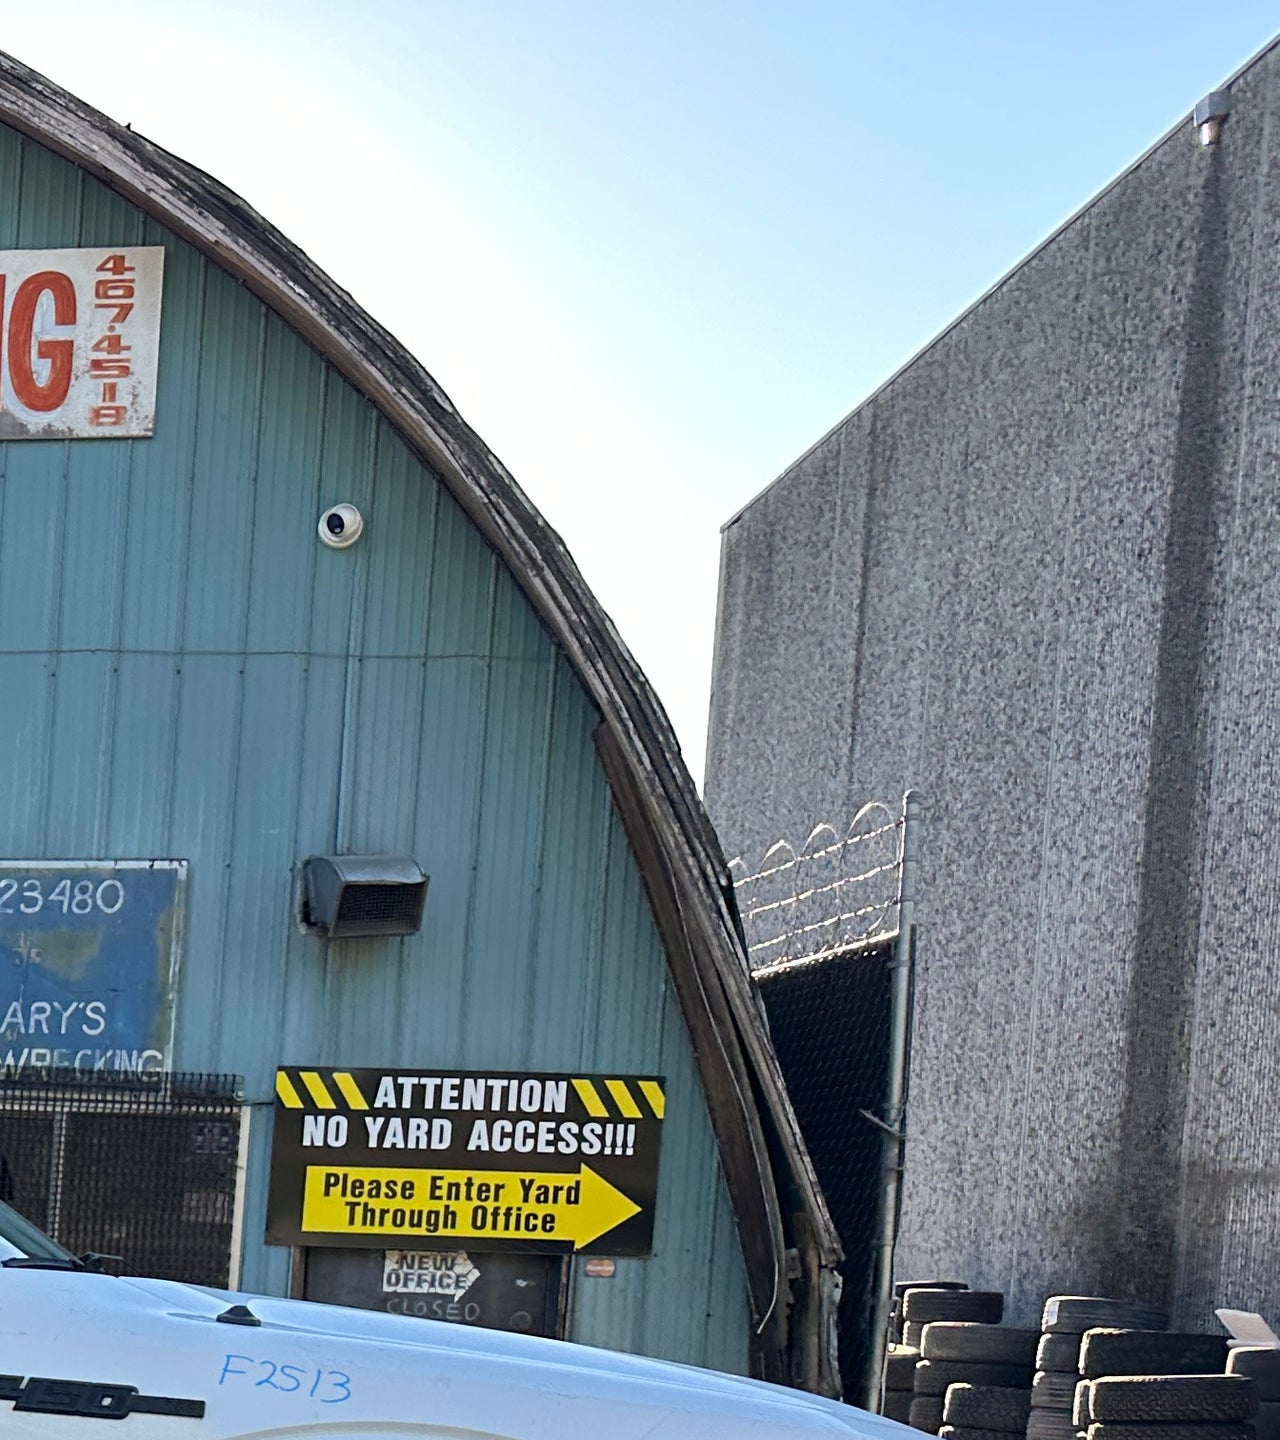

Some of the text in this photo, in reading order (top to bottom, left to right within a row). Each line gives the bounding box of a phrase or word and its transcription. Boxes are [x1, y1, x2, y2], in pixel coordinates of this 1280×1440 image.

[374, 1075, 569, 1114] ATTENTION
[302, 1115, 637, 1156] NO YARD ACCESS!!!
[323, 1172, 581, 1206] Please Enter Yard
[344, 1201, 556, 1234] Through Office
[397, 1252, 455, 1271] NEW
[386, 1268, 469, 1290] OFFICE
[218, 1354, 352, 1403] F2513
